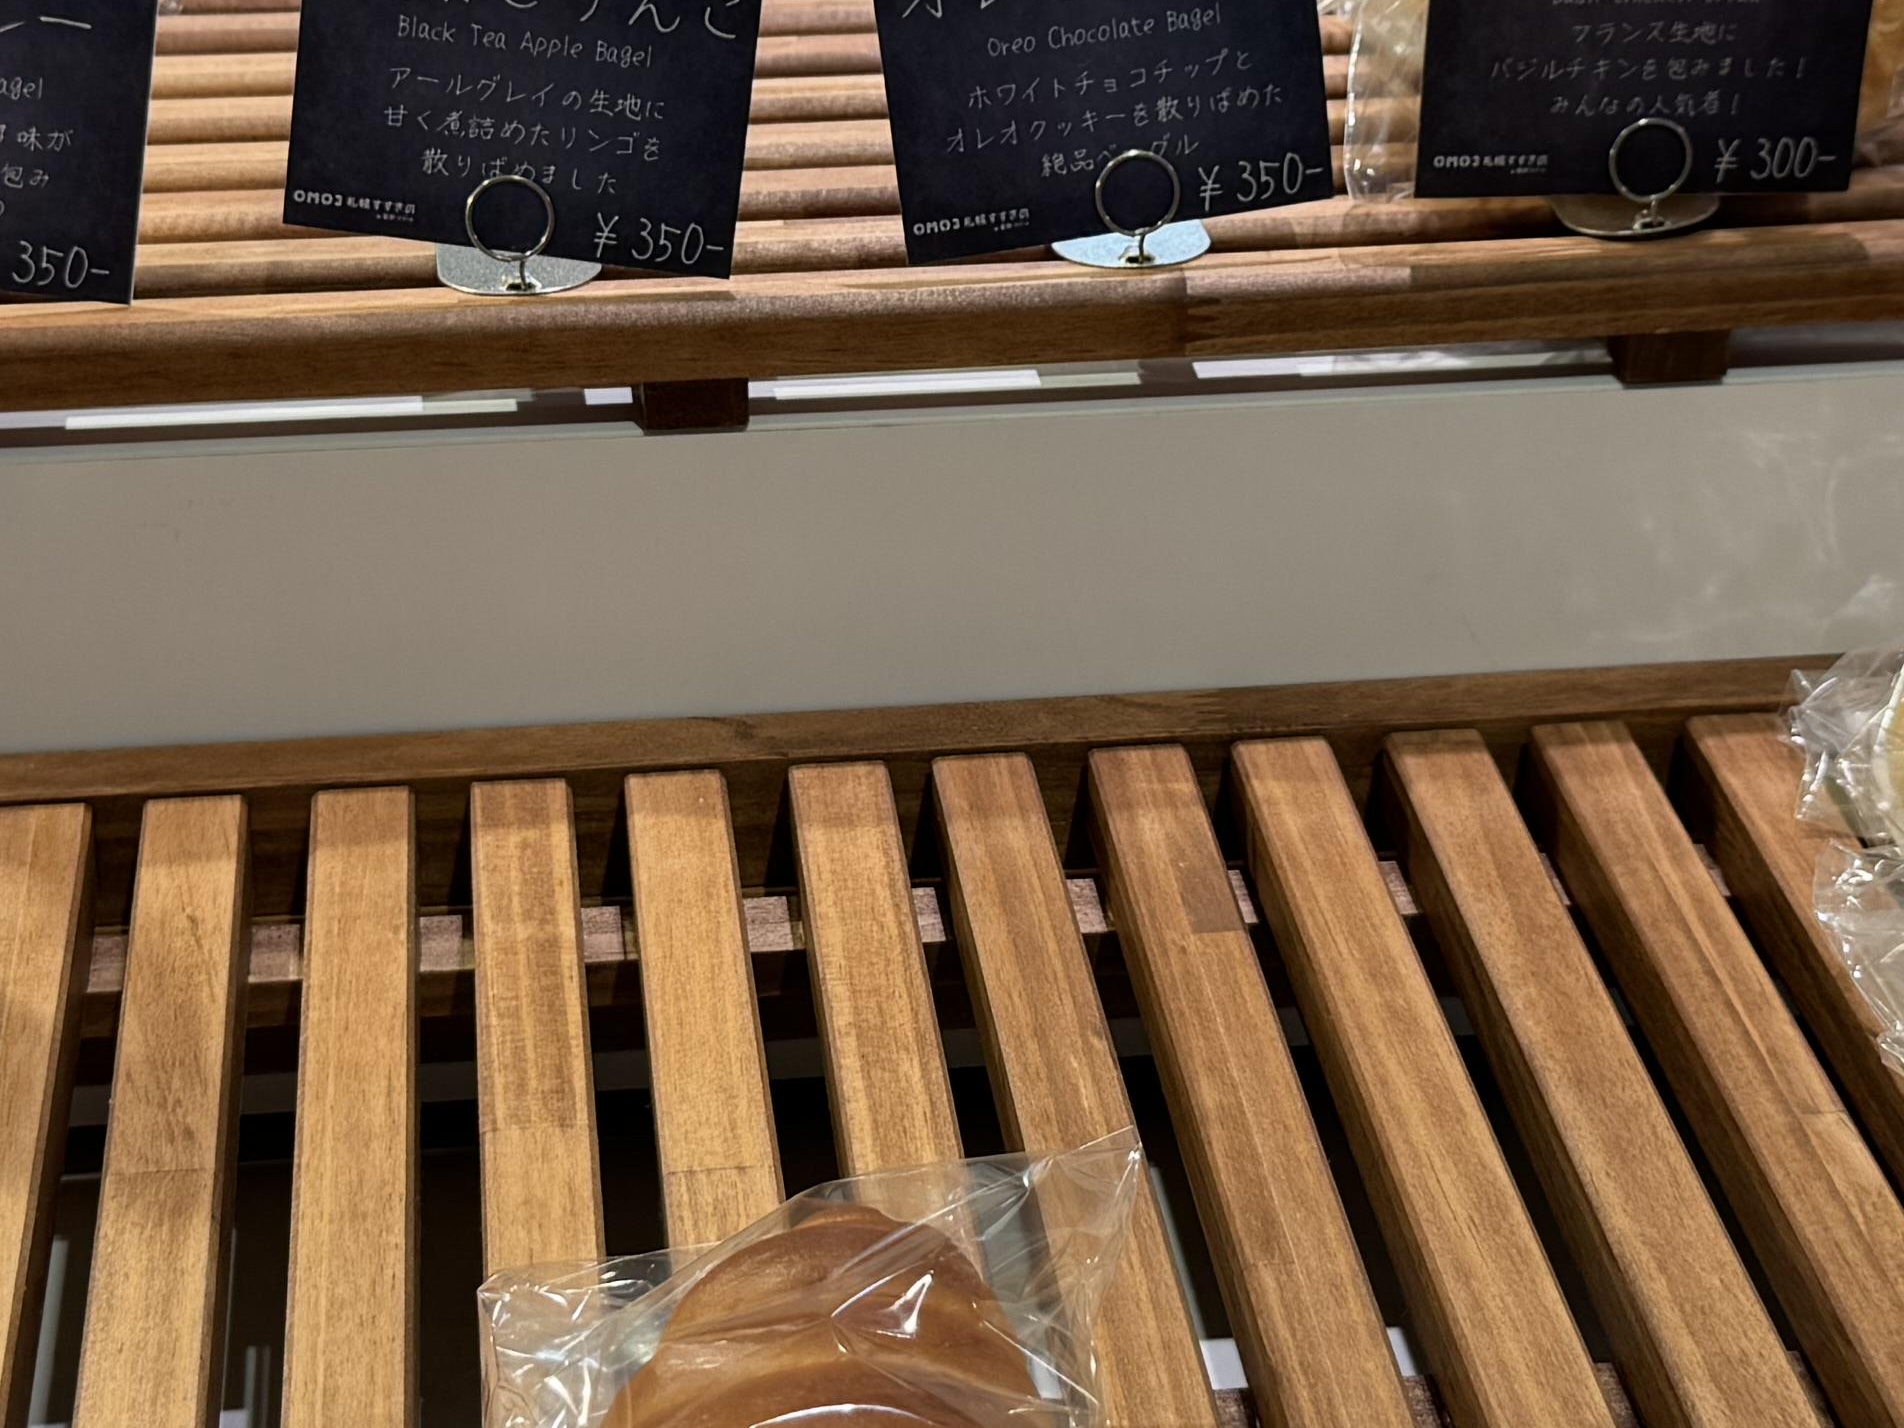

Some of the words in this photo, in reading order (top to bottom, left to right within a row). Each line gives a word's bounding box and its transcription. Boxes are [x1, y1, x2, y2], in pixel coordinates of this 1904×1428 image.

[397, 14, 454, 43] Black
[470, 23, 506, 50] Tea
[520, 31, 583, 58] Apple
[596, 39, 653, 68] Bagel
[987, 30, 1036, 57] Oreo
[1047, 15, 1155, 48] Chocolate
[1166, 3, 1222, 33] Bagel
[389, 68, 665, 119] アールグレイの生地に
